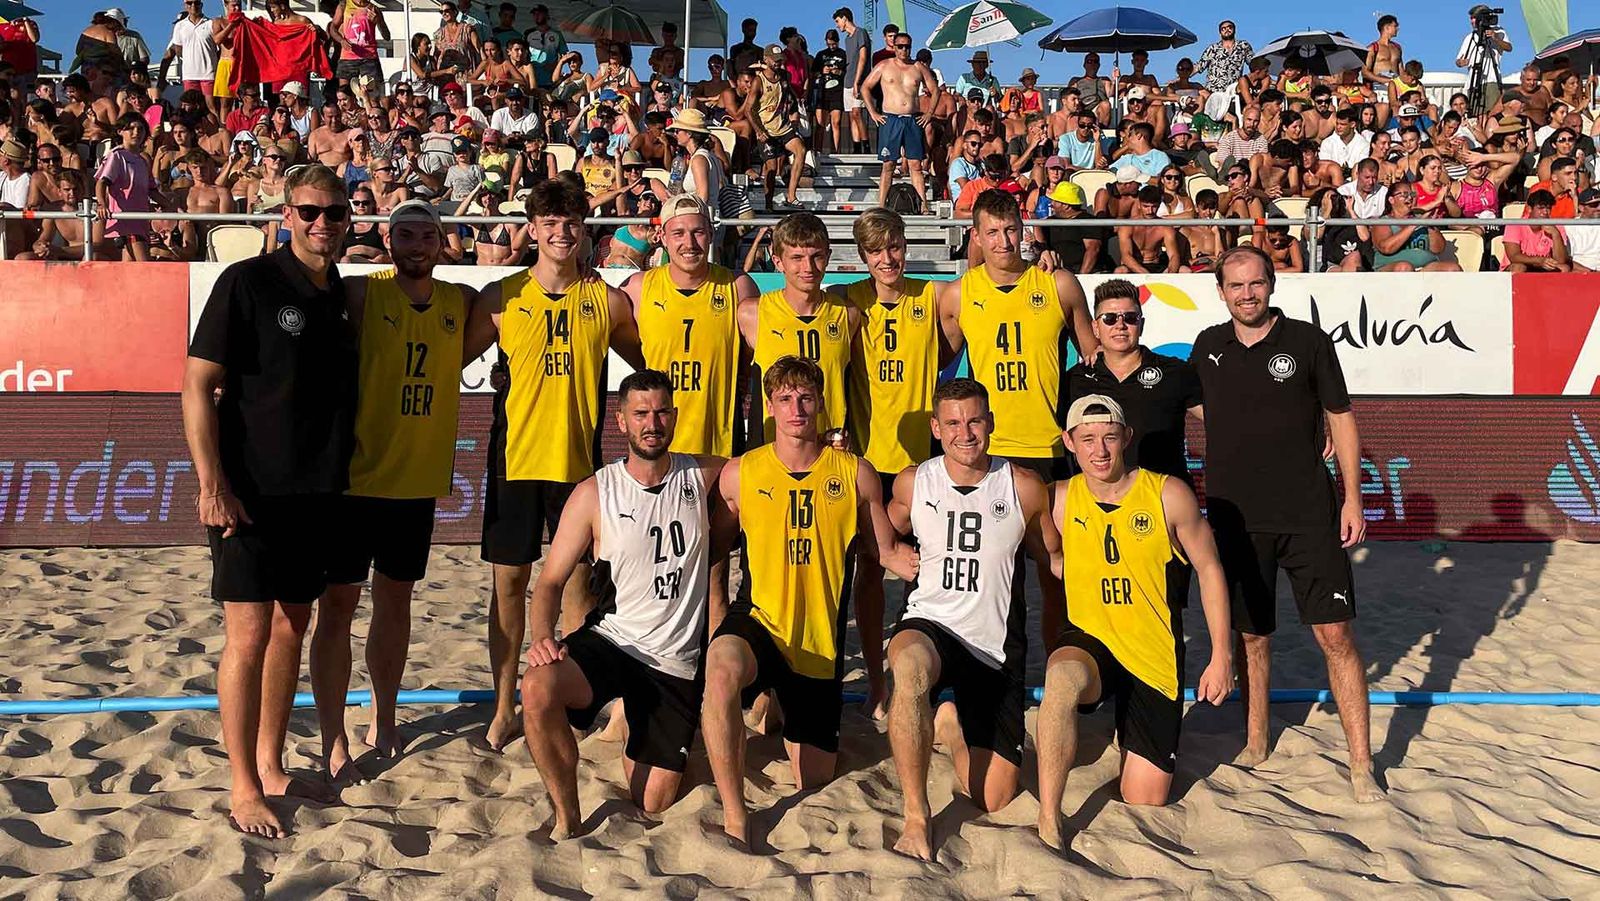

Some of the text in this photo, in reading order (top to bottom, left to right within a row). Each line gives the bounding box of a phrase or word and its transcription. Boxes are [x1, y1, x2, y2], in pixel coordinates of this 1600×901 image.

[969, 15, 993, 30] San
[544, 309, 570, 346] 14
[682, 318, 695, 353] 7
[883, 318, 898, 353] 5
[995, 321, 1023, 356] 41
[405, 341, 428, 378] 12
[796, 329, 821, 363] 10
[544, 351, 571, 377] GER
[670, 360, 702, 392] GER
[878, 359, 905, 383] GER
[995, 360, 1029, 392] GER
[400, 383, 434, 417] GER
[788, 488, 815, 531] 13
[649, 520, 686, 565] 20
[946, 509, 983, 553] 18
[1103, 523, 1121, 566] 6
[788, 538, 812, 566] GER
[941, 556, 980, 593] GER
[1100, 577, 1134, 606] GER
